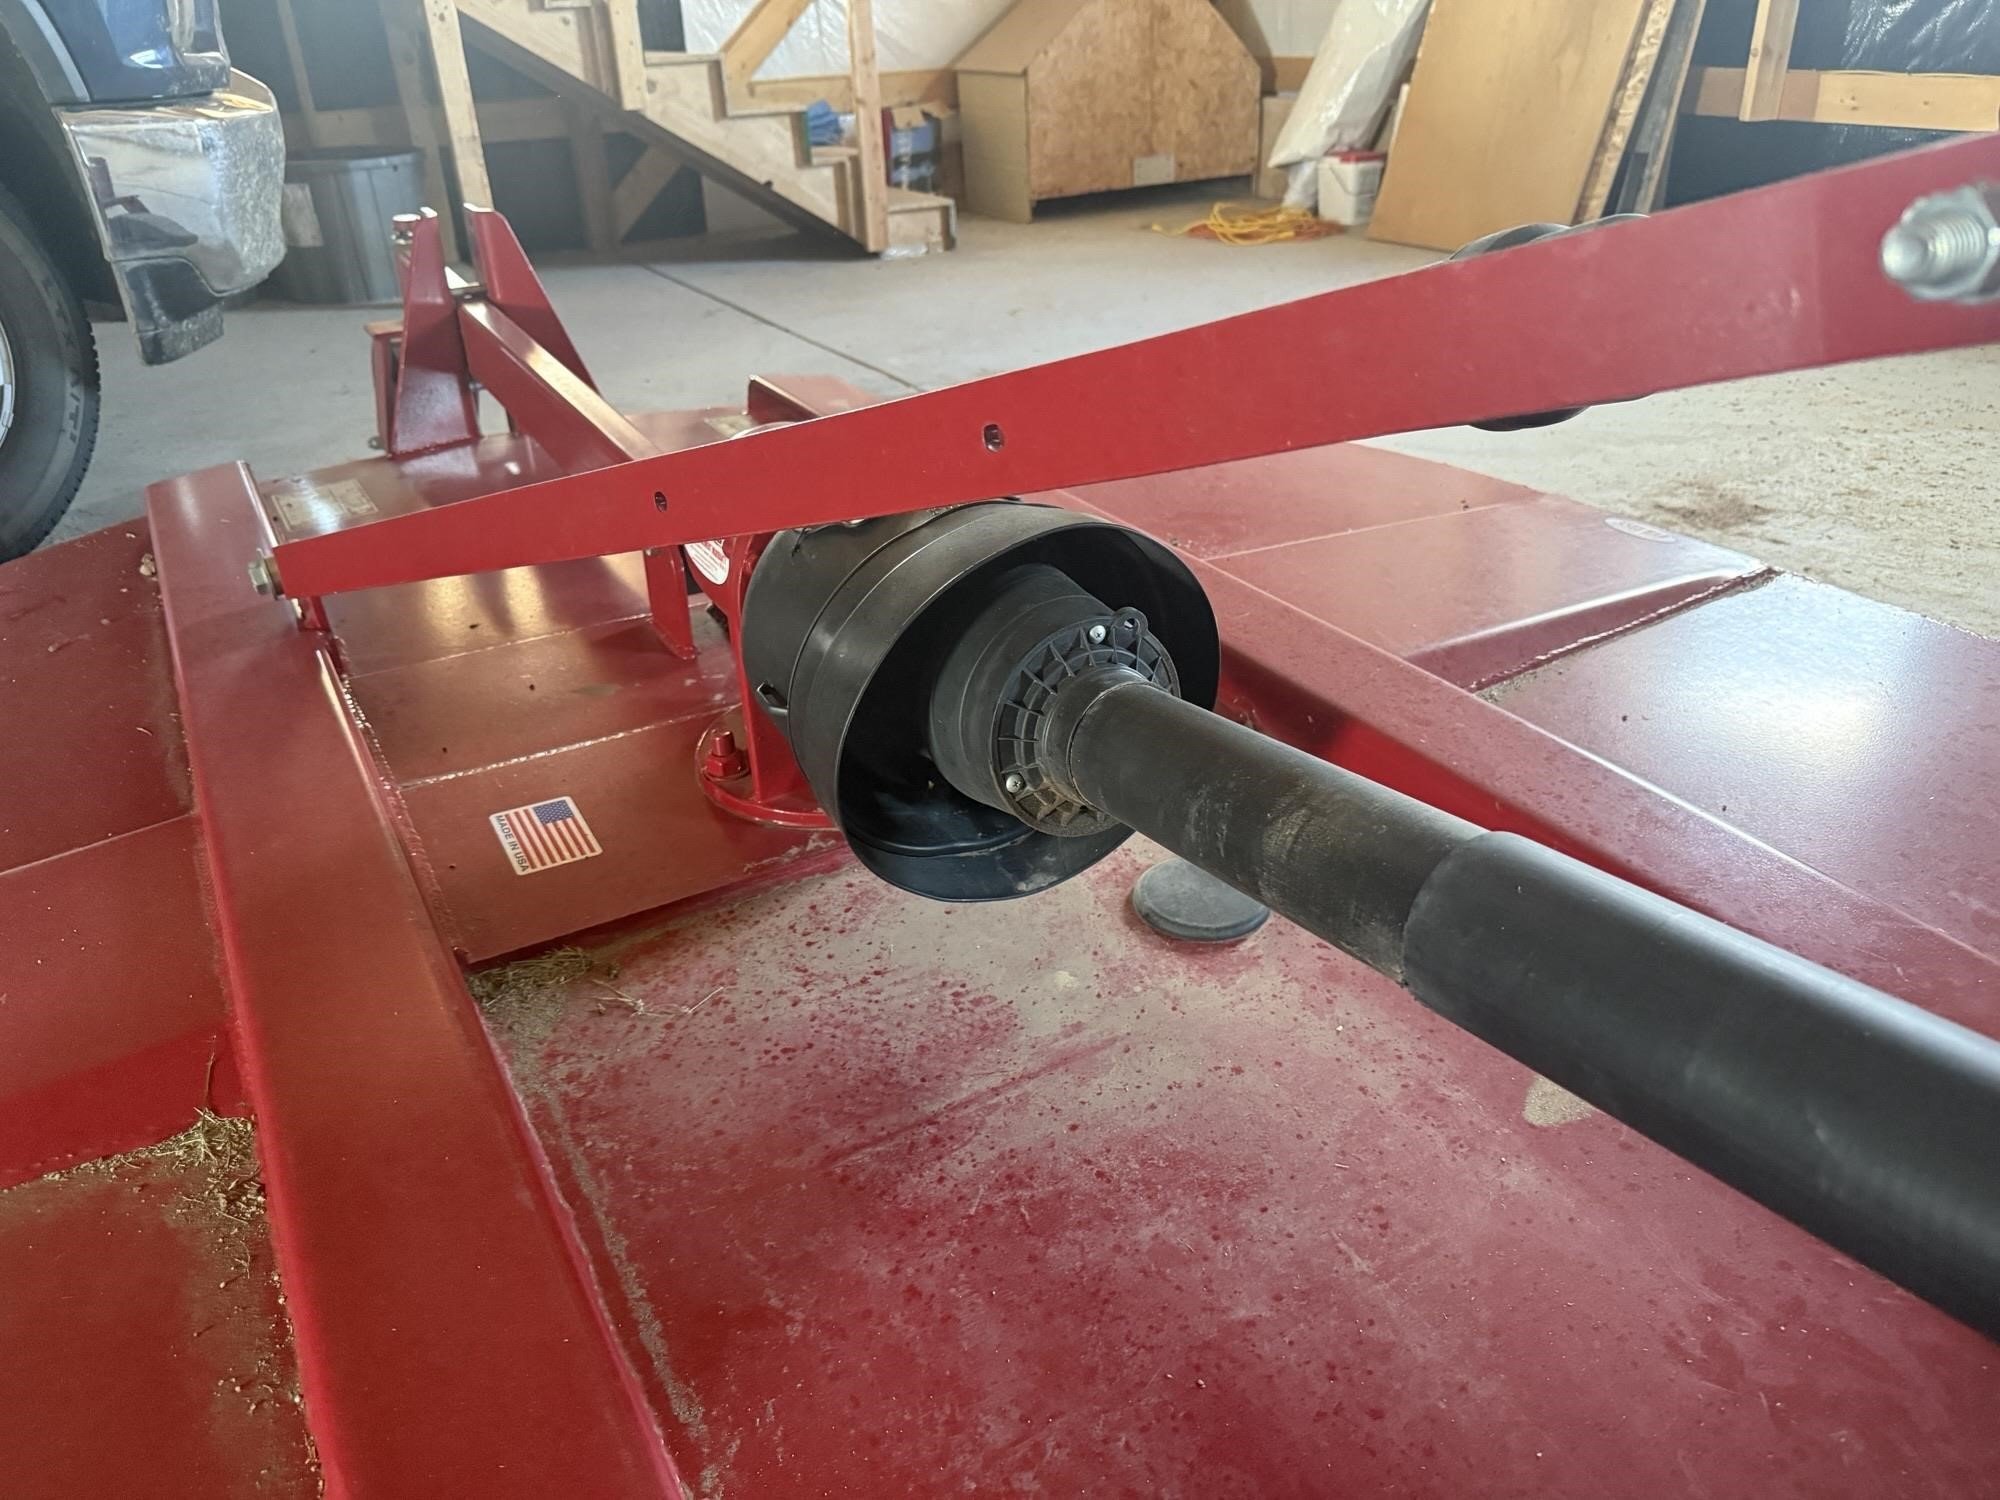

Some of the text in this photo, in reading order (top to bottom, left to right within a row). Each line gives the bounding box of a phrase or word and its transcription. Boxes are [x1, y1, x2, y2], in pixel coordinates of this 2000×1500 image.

[495, 815, 529, 872] MADE IN USA
